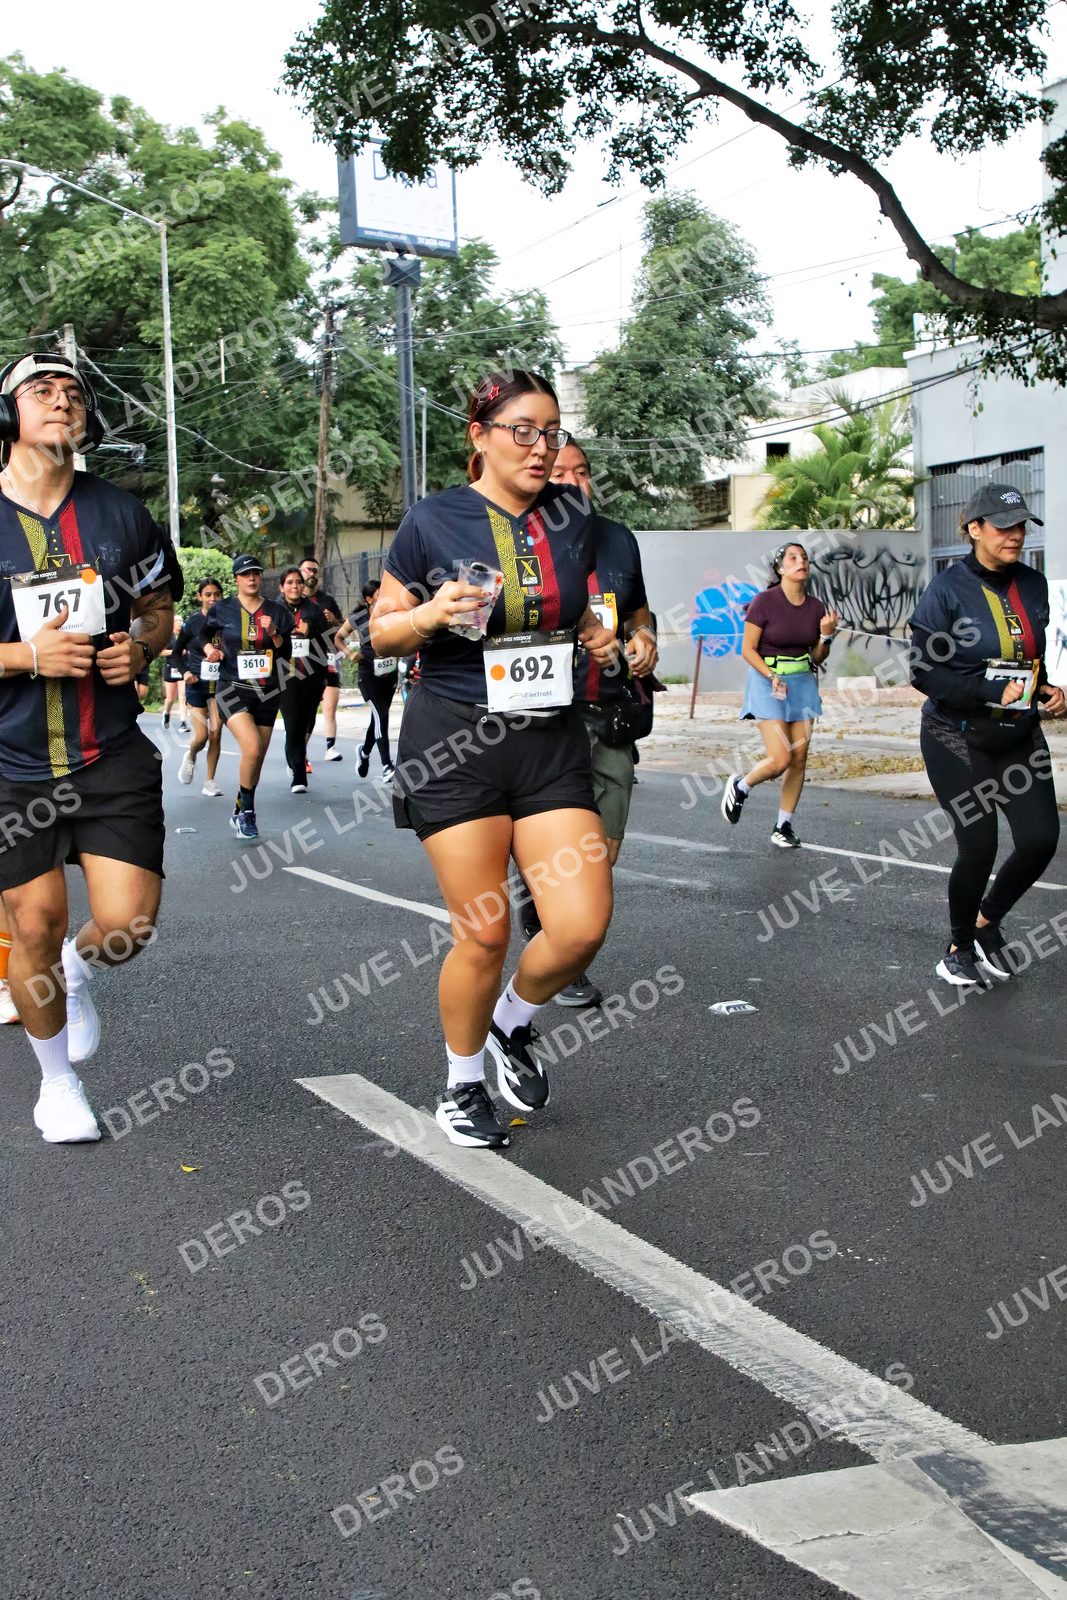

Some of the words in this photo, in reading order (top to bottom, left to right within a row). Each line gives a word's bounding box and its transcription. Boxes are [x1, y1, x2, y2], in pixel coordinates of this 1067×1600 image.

[38, 588, 81, 617] 767
[243, 658, 265, 668] 3610
[378, 659, 393, 668] 6522
[510, 655, 554, 682] 692
